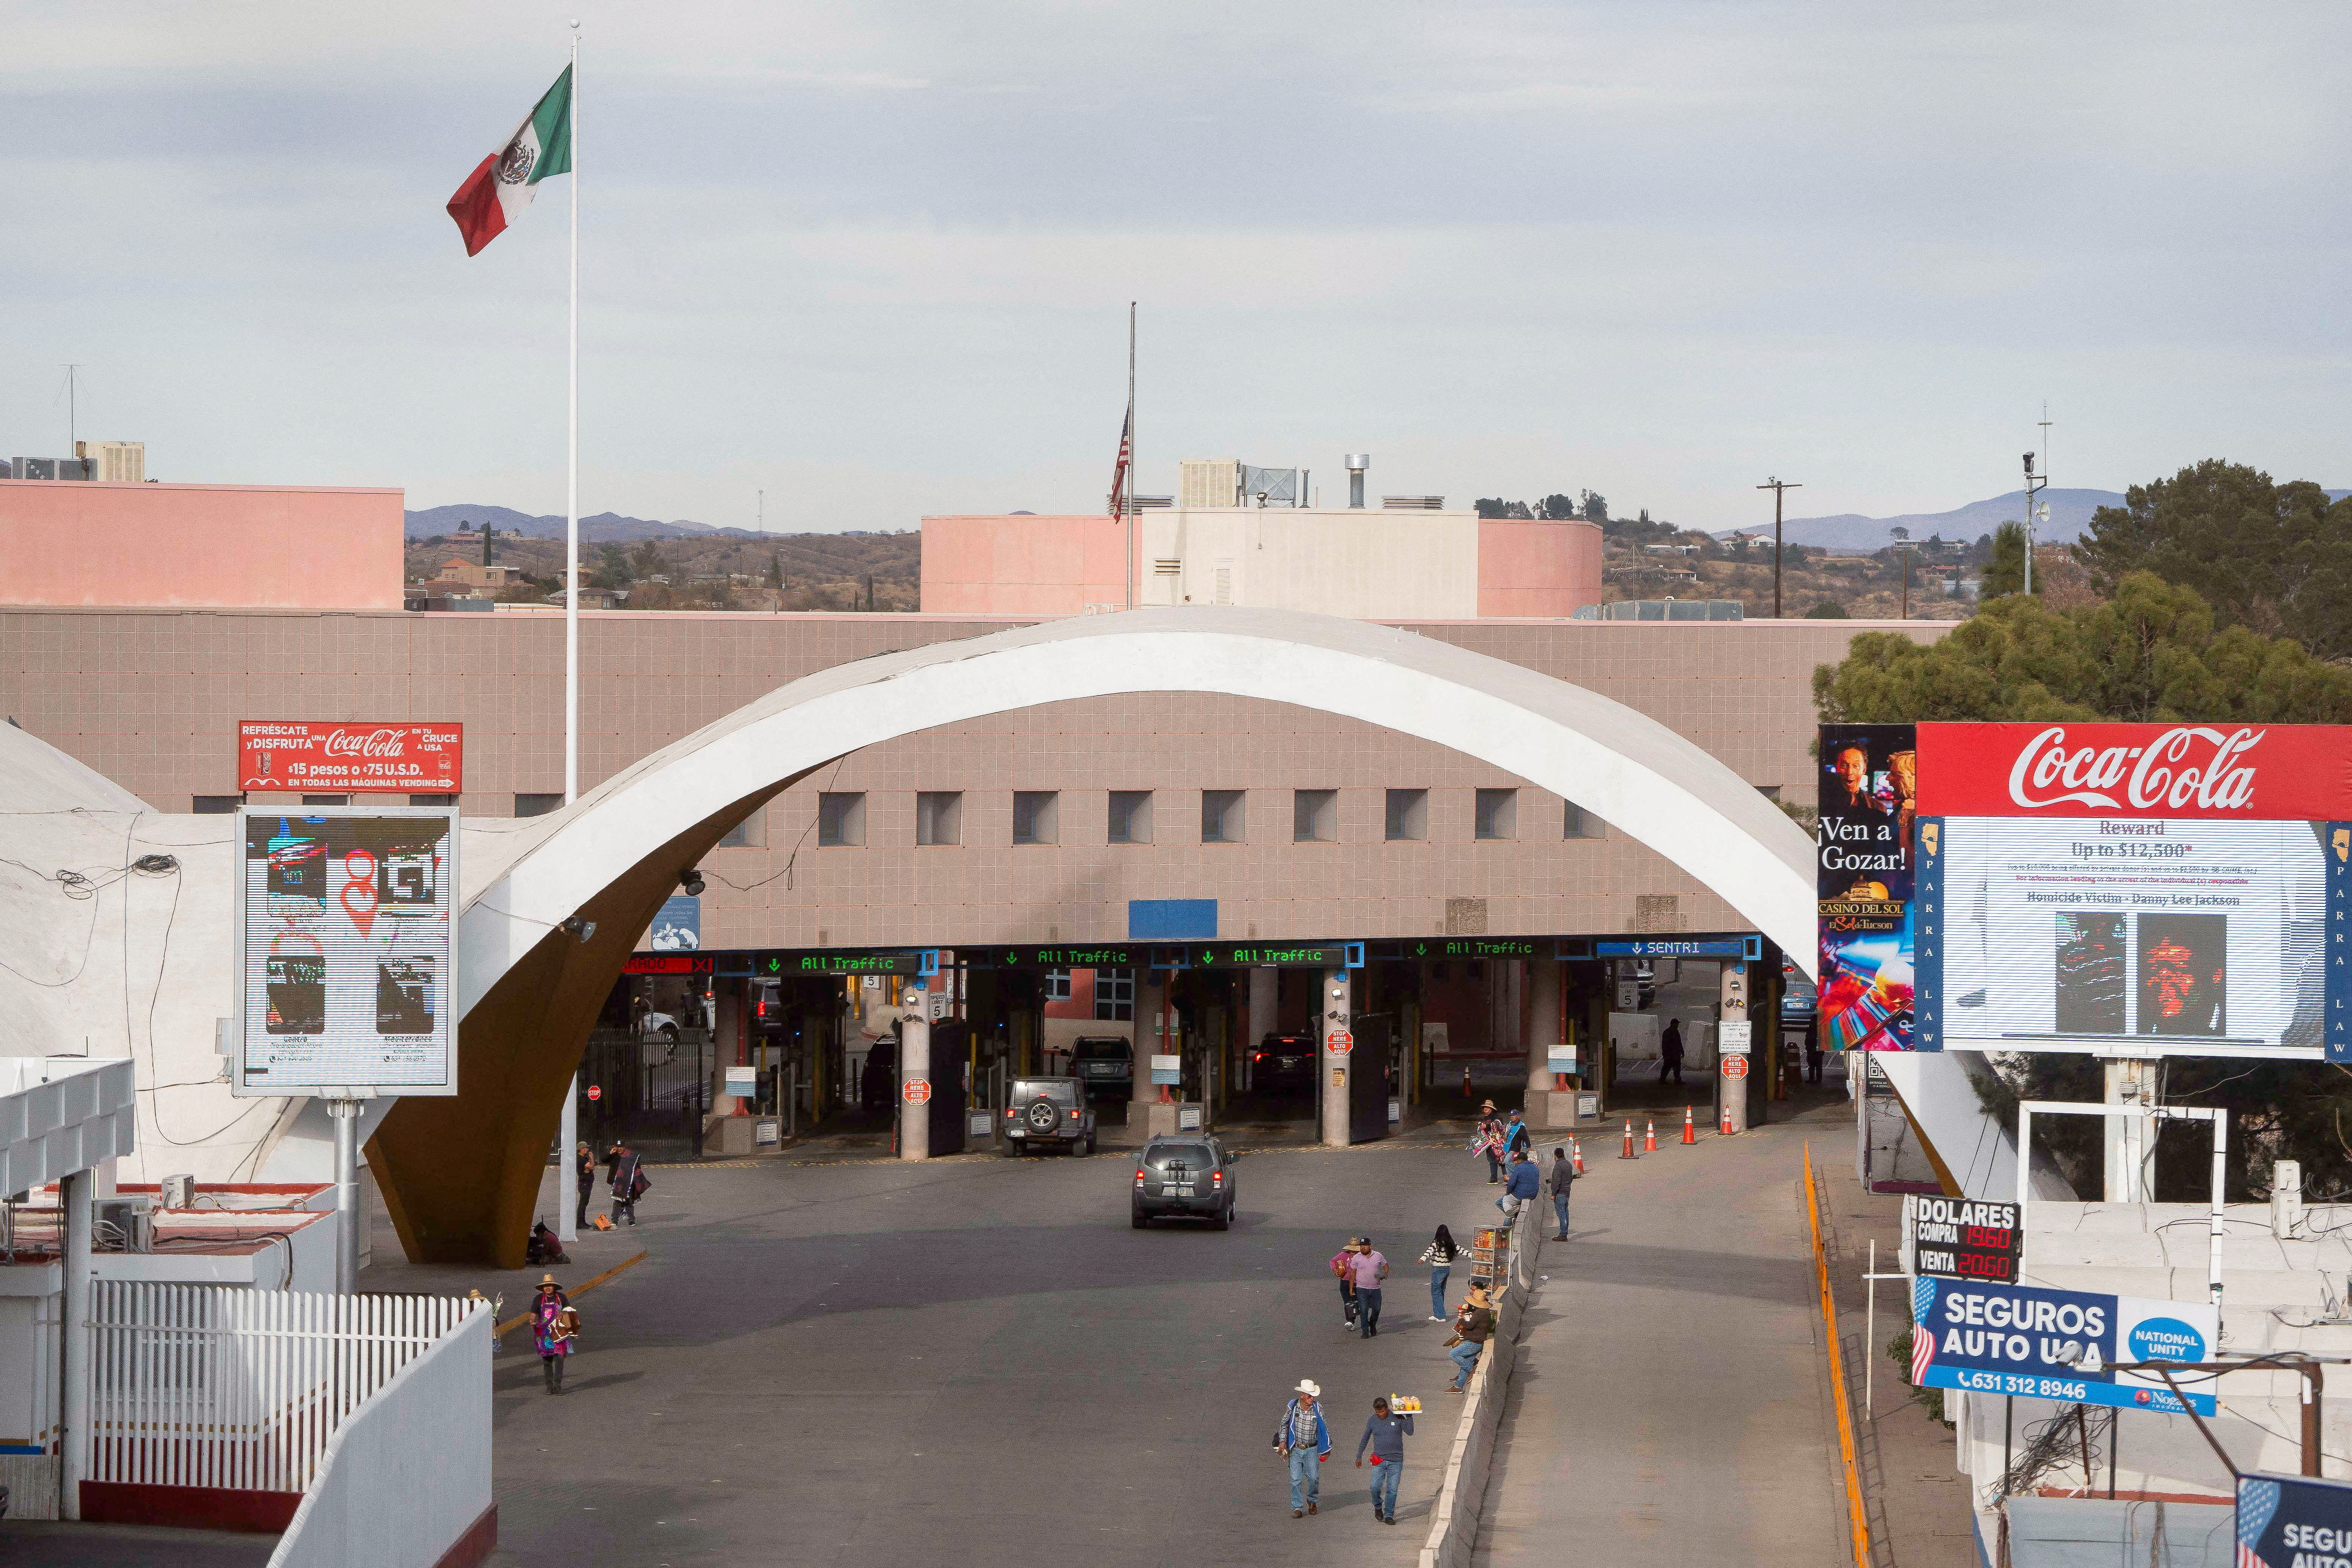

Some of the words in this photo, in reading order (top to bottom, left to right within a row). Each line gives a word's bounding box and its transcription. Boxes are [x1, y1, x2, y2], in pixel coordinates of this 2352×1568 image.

[243, 724, 308, 735] REFRÉSCATE
[254, 738, 313, 749] DISFRUTA
[325, 729, 408, 757] Coca-Cola
[422, 734, 457, 743] CRUCE
[288, 763, 306, 775] $15
[310, 765, 347, 777] pesos
[351, 765, 360, 775] o
[385, 764, 423, 776] U.S.D.
[2009, 727, 2266, 808] Coca-Cola
[351, 778, 396, 786] MÁQUINAS
[1817, 817, 1869, 846] ¡Ven
[1877, 825, 1892, 840] a
[2100, 820, 2164, 835] Reward
[1822, 846, 1905, 870] Gozar!
[2072, 843, 2093, 860] Up
[2098, 844, 2113, 856] to
[2028, 892, 2082, 902] Homicide
[2086, 892, 2122, 903] Victim
[2132, 893, 2167, 906] Danny
[2172, 894, 2192, 904] Lee
[2195, 894, 2240, 906] Jackson
[1819, 904, 1859, 913] CASINO
[1862, 904, 1882, 913] DEL
[1883, 904, 1903, 913] SOL
[1835, 916, 1855, 930] Sol
[1860, 920, 1893, 929] Tucson
[1447, 943, 1470, 953] All
[1476, 943, 1532, 953] Traffic
[1647, 943, 1699, 953] SENTRI
[1039, 951, 1063, 962] All
[1069, 951, 1127, 962] Traffic
[1234, 950, 1257, 961] All
[1265, 950, 1322, 961] Traffic
[802, 957, 826, 969] All
[833, 957, 894, 969] Traffic
[868, 977, 874, 986] 5
[1624, 996, 1631, 1005] 5
[934, 1006, 940, 1016] 5
[1919, 1198, 2015, 1229] DOLARES
[1918, 1222, 1958, 1243] COMPRA
[1920, 1250, 1956, 1272] VENTA
[1945, 1292, 2105, 1337] SEGUROS
[2135, 1330, 2198, 1346] NATIONAL
[1942, 1328, 2030, 1361] AUTO
[2040, 1337, 2102, 1366] UA
[2148, 1343, 2186, 1356] UNITY
[1972, 1373, 2001, 1390] 631
[2006, 1376, 2035, 1394] 312
[2040, 1380, 2086, 1399] 8946
